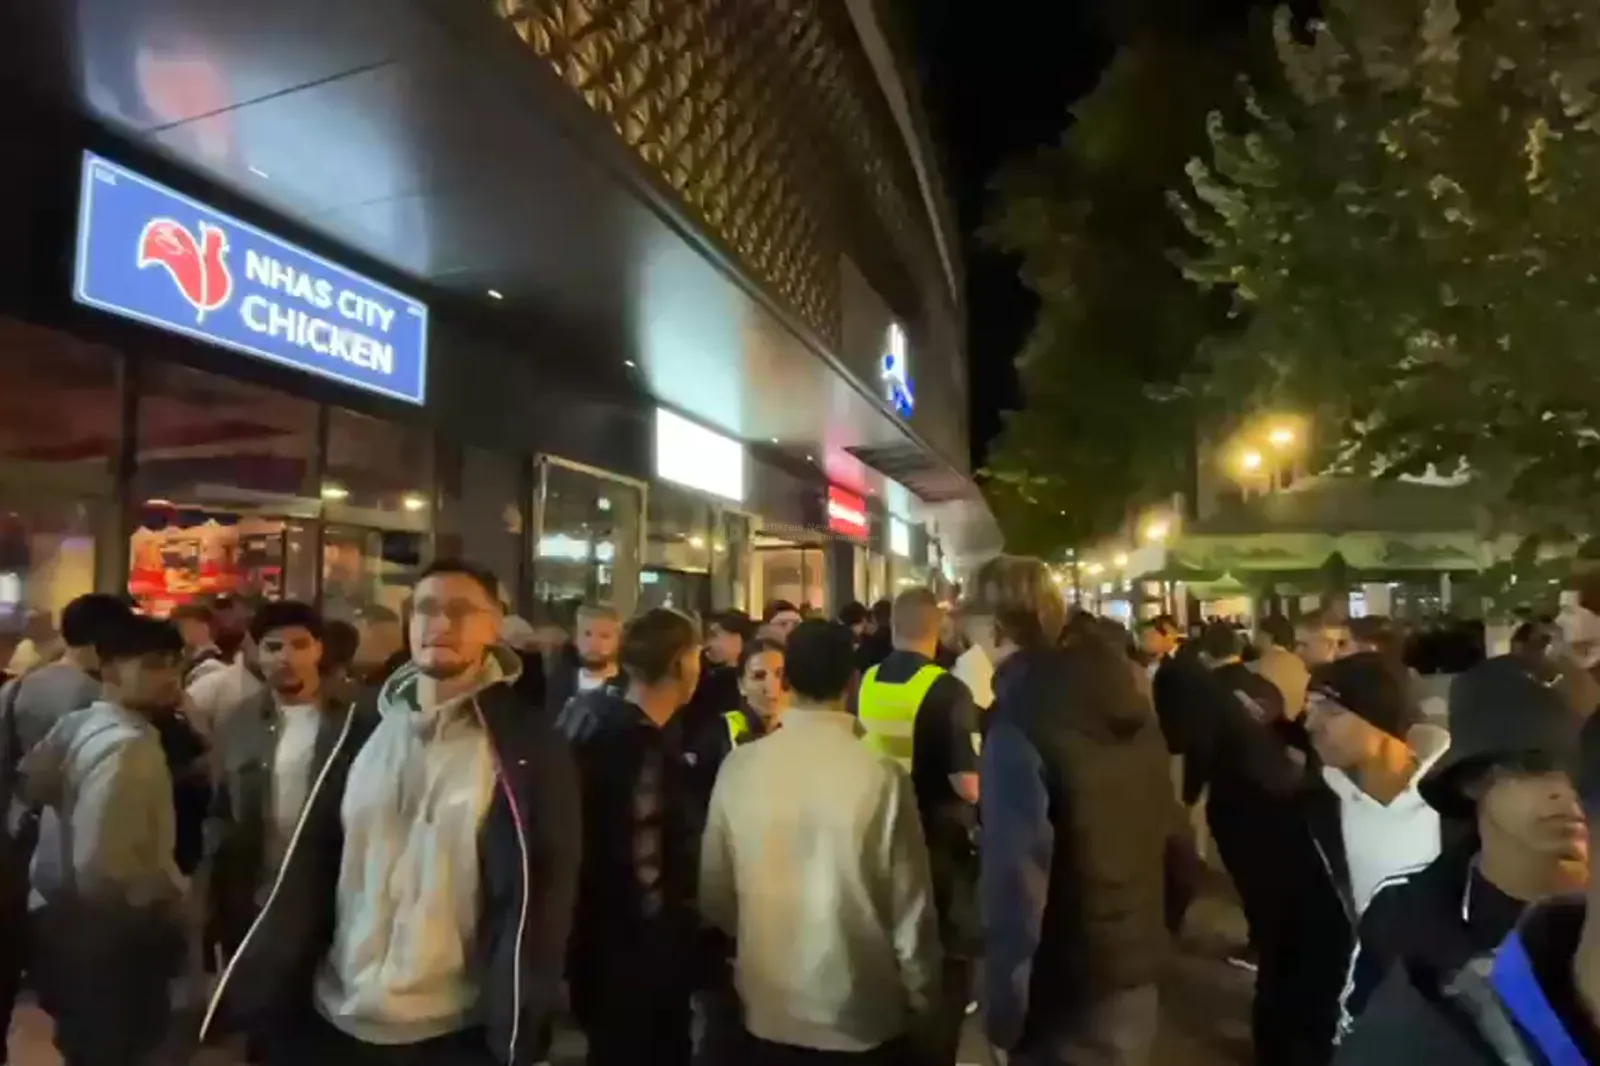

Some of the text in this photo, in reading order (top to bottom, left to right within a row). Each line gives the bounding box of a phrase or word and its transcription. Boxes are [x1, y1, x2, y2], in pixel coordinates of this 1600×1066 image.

[245, 250, 394, 332] NHAS CITY
[241, 296, 393, 374] CHICKEN
